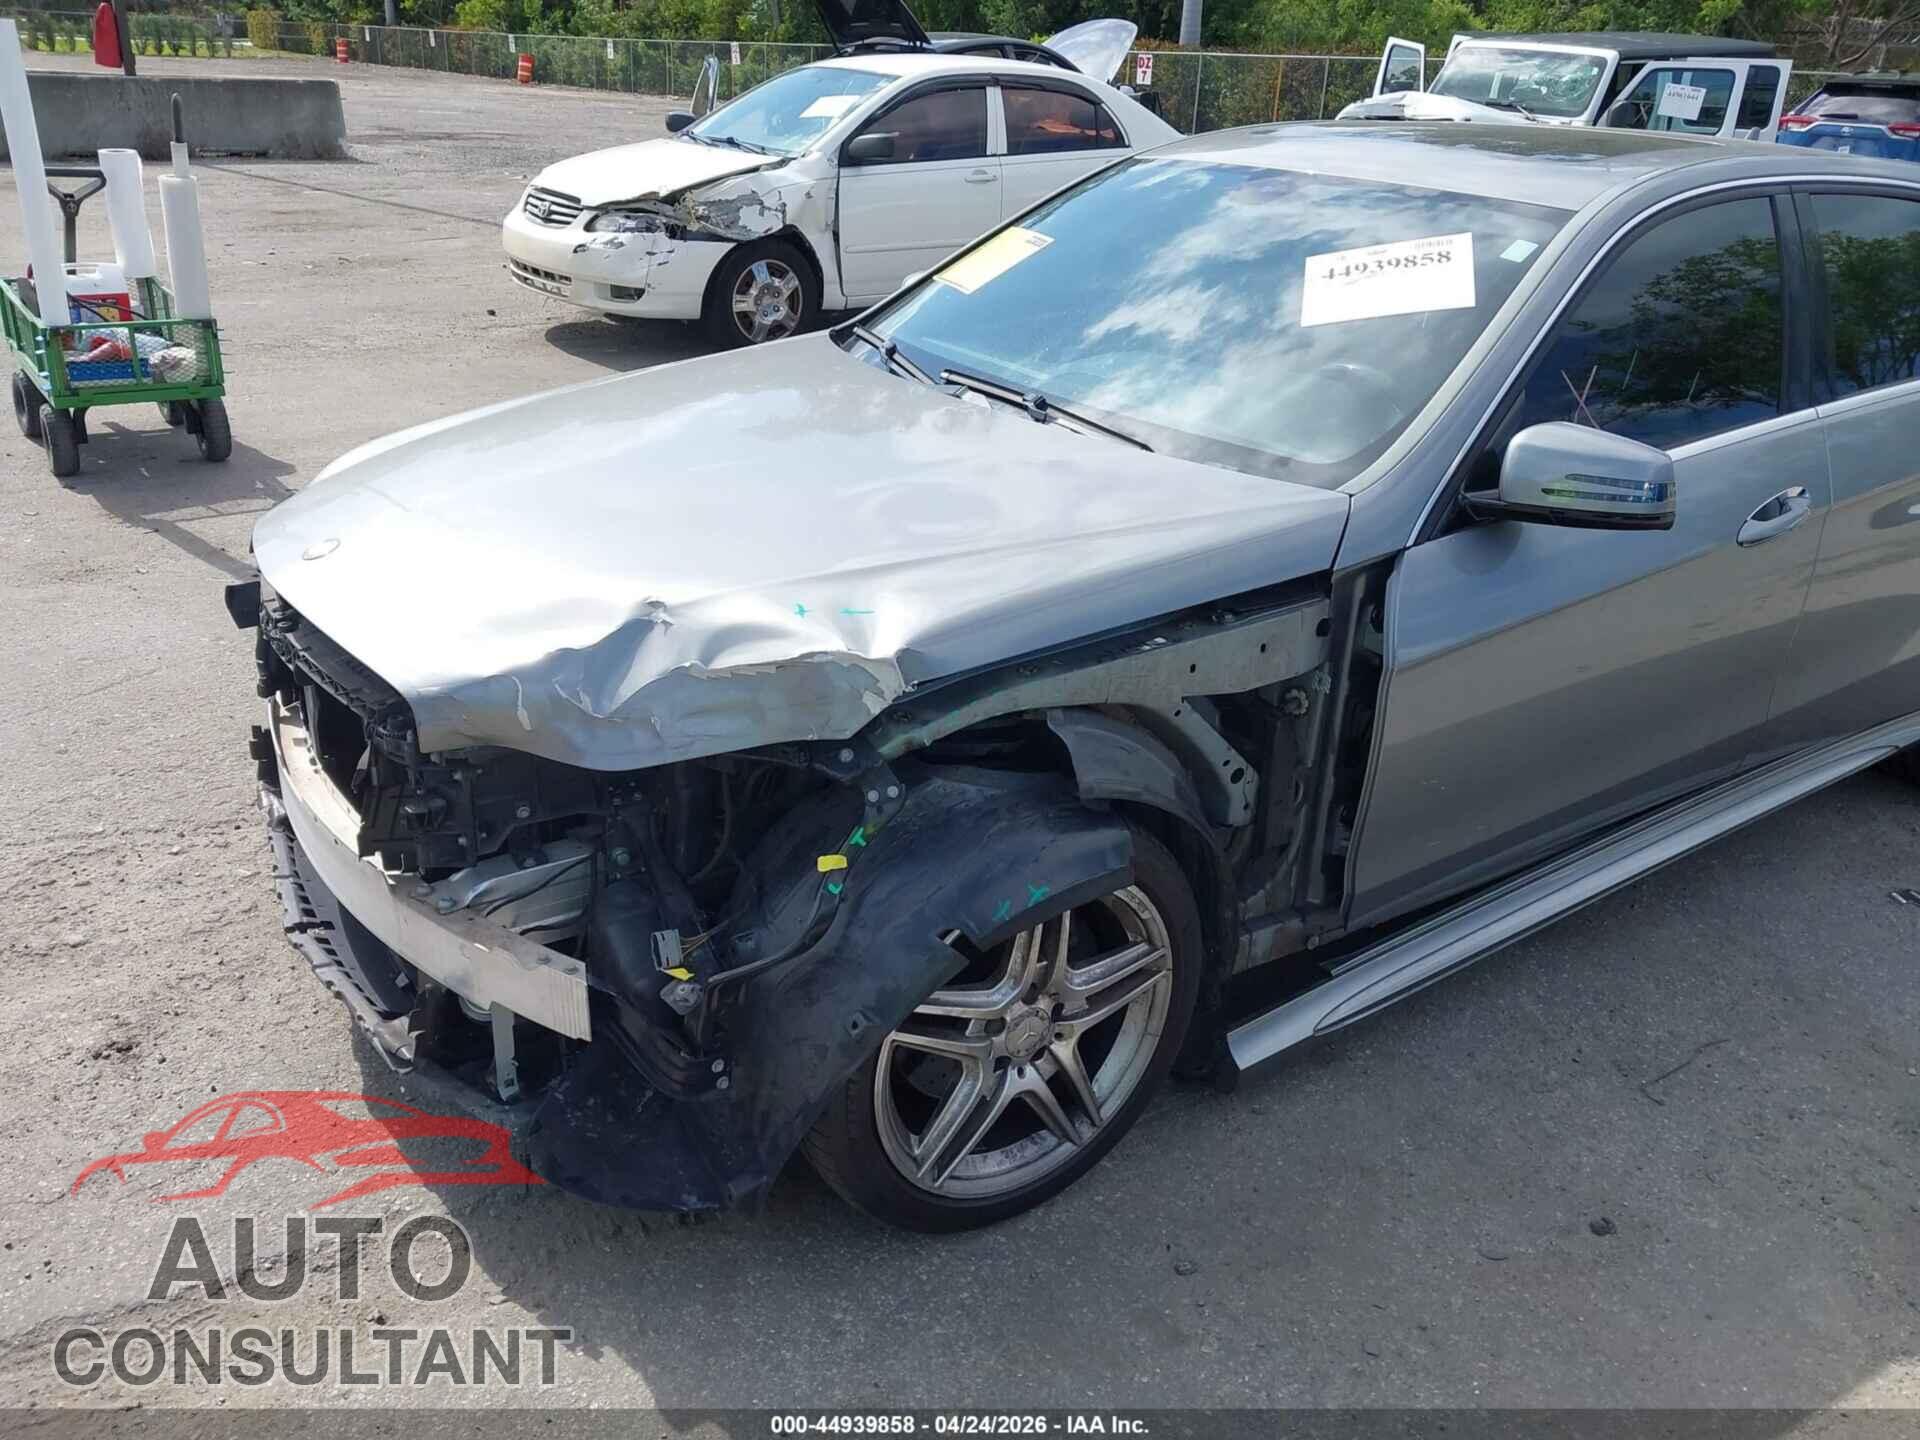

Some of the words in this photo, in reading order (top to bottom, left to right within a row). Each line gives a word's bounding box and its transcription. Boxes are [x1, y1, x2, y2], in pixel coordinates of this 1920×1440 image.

[1138, 57, 1151, 69] DZ
[1141, 70, 1147, 82] 7
[1321, 250, 1452, 280] 44939858
